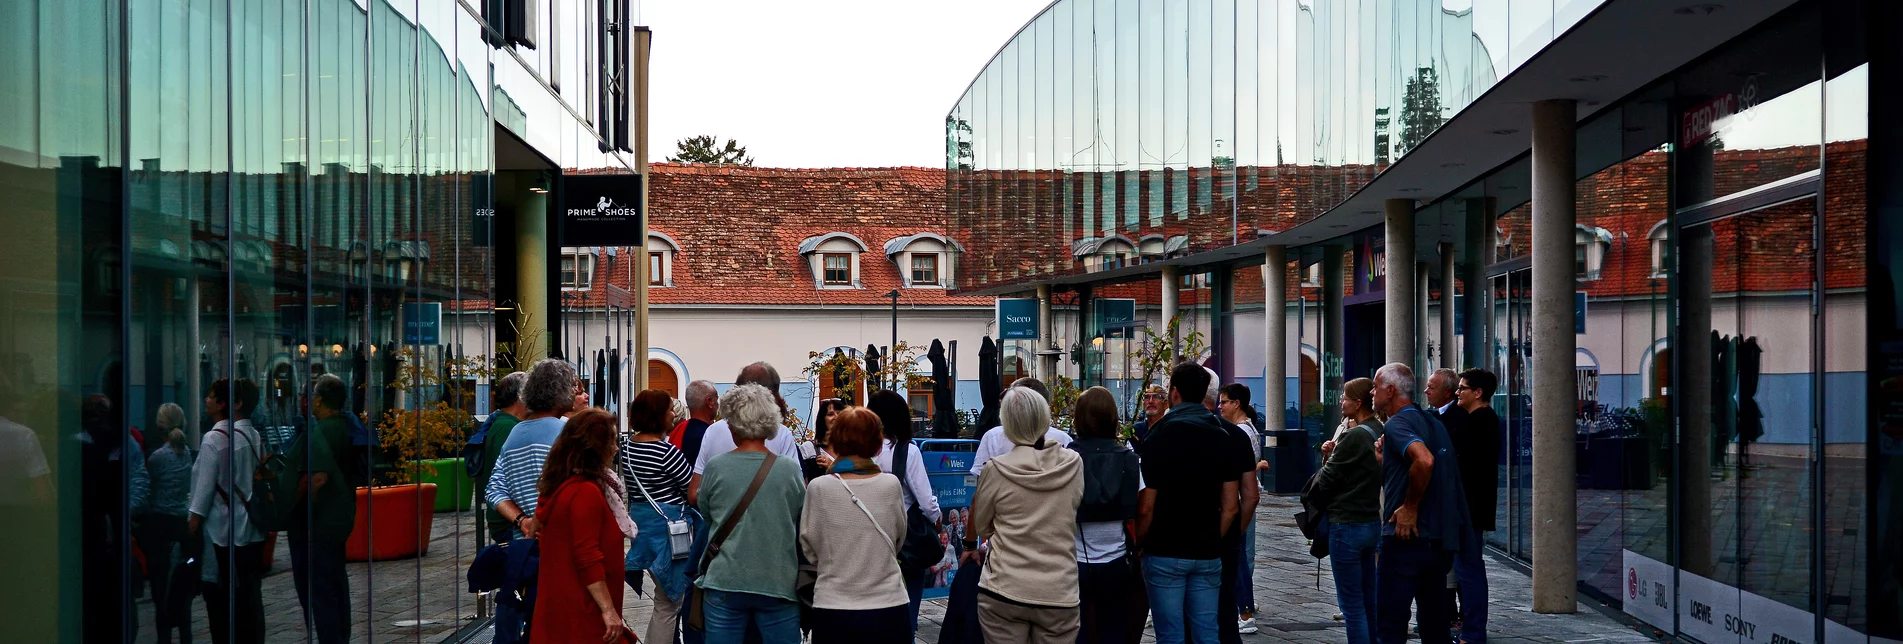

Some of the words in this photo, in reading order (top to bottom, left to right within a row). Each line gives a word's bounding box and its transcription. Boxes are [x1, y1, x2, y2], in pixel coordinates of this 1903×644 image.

[1692, 106, 1711, 139] RED
[567, 208, 597, 216] PRIME
[605, 208, 636, 216] SHOES
[1006, 314, 1031, 323] Sacco
[950, 459, 965, 468] Weiz
[953, 488, 967, 496] EINS
[1638, 578, 1647, 597] LG
[1654, 581, 1668, 609] JBL
[1724, 613, 1756, 641] SONY
